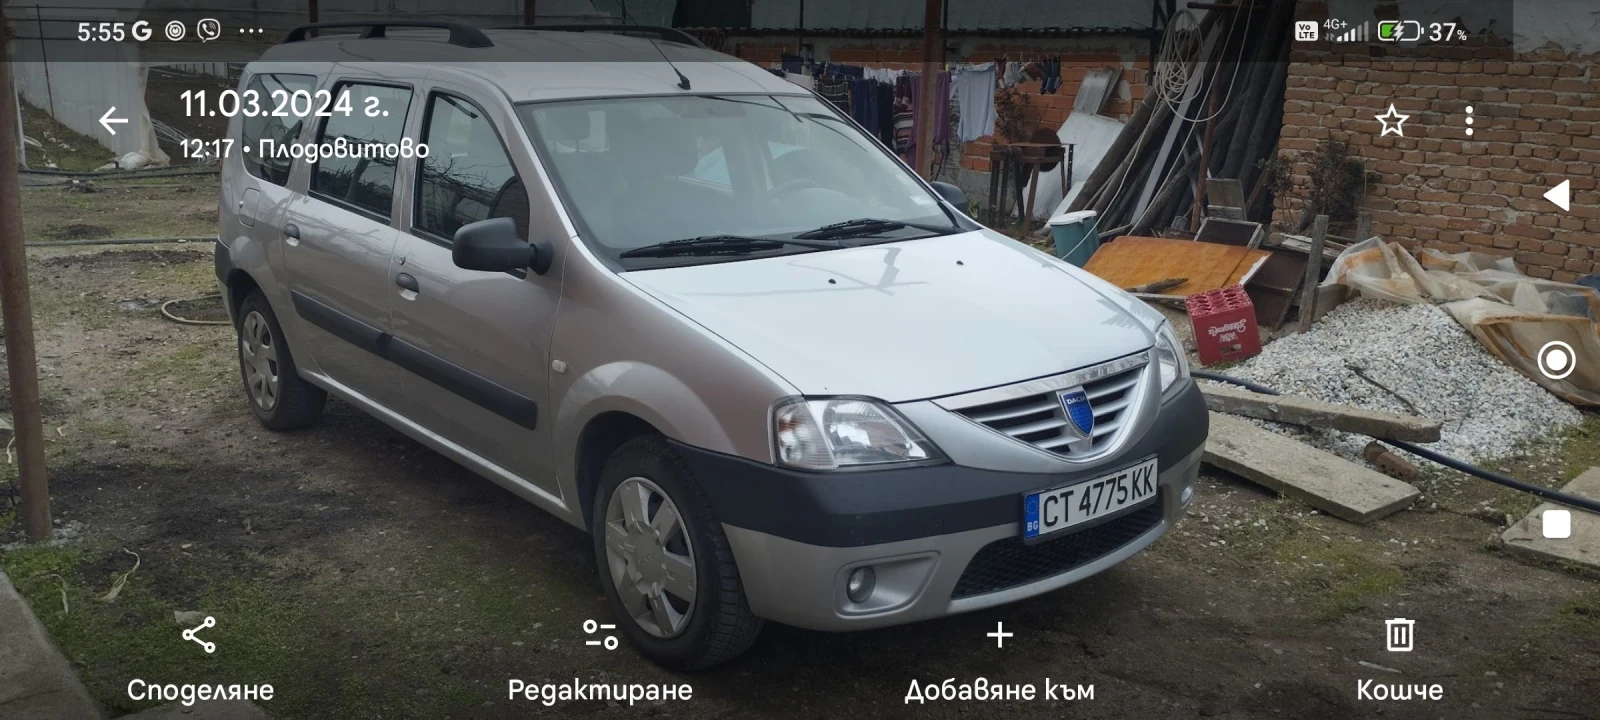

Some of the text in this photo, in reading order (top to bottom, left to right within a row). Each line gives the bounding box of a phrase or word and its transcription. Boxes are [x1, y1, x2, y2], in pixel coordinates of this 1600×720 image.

[1079, 473, 1128, 516] 4775
[1131, 463, 1154, 500] KK
[1027, 520, 1039, 532] BG
